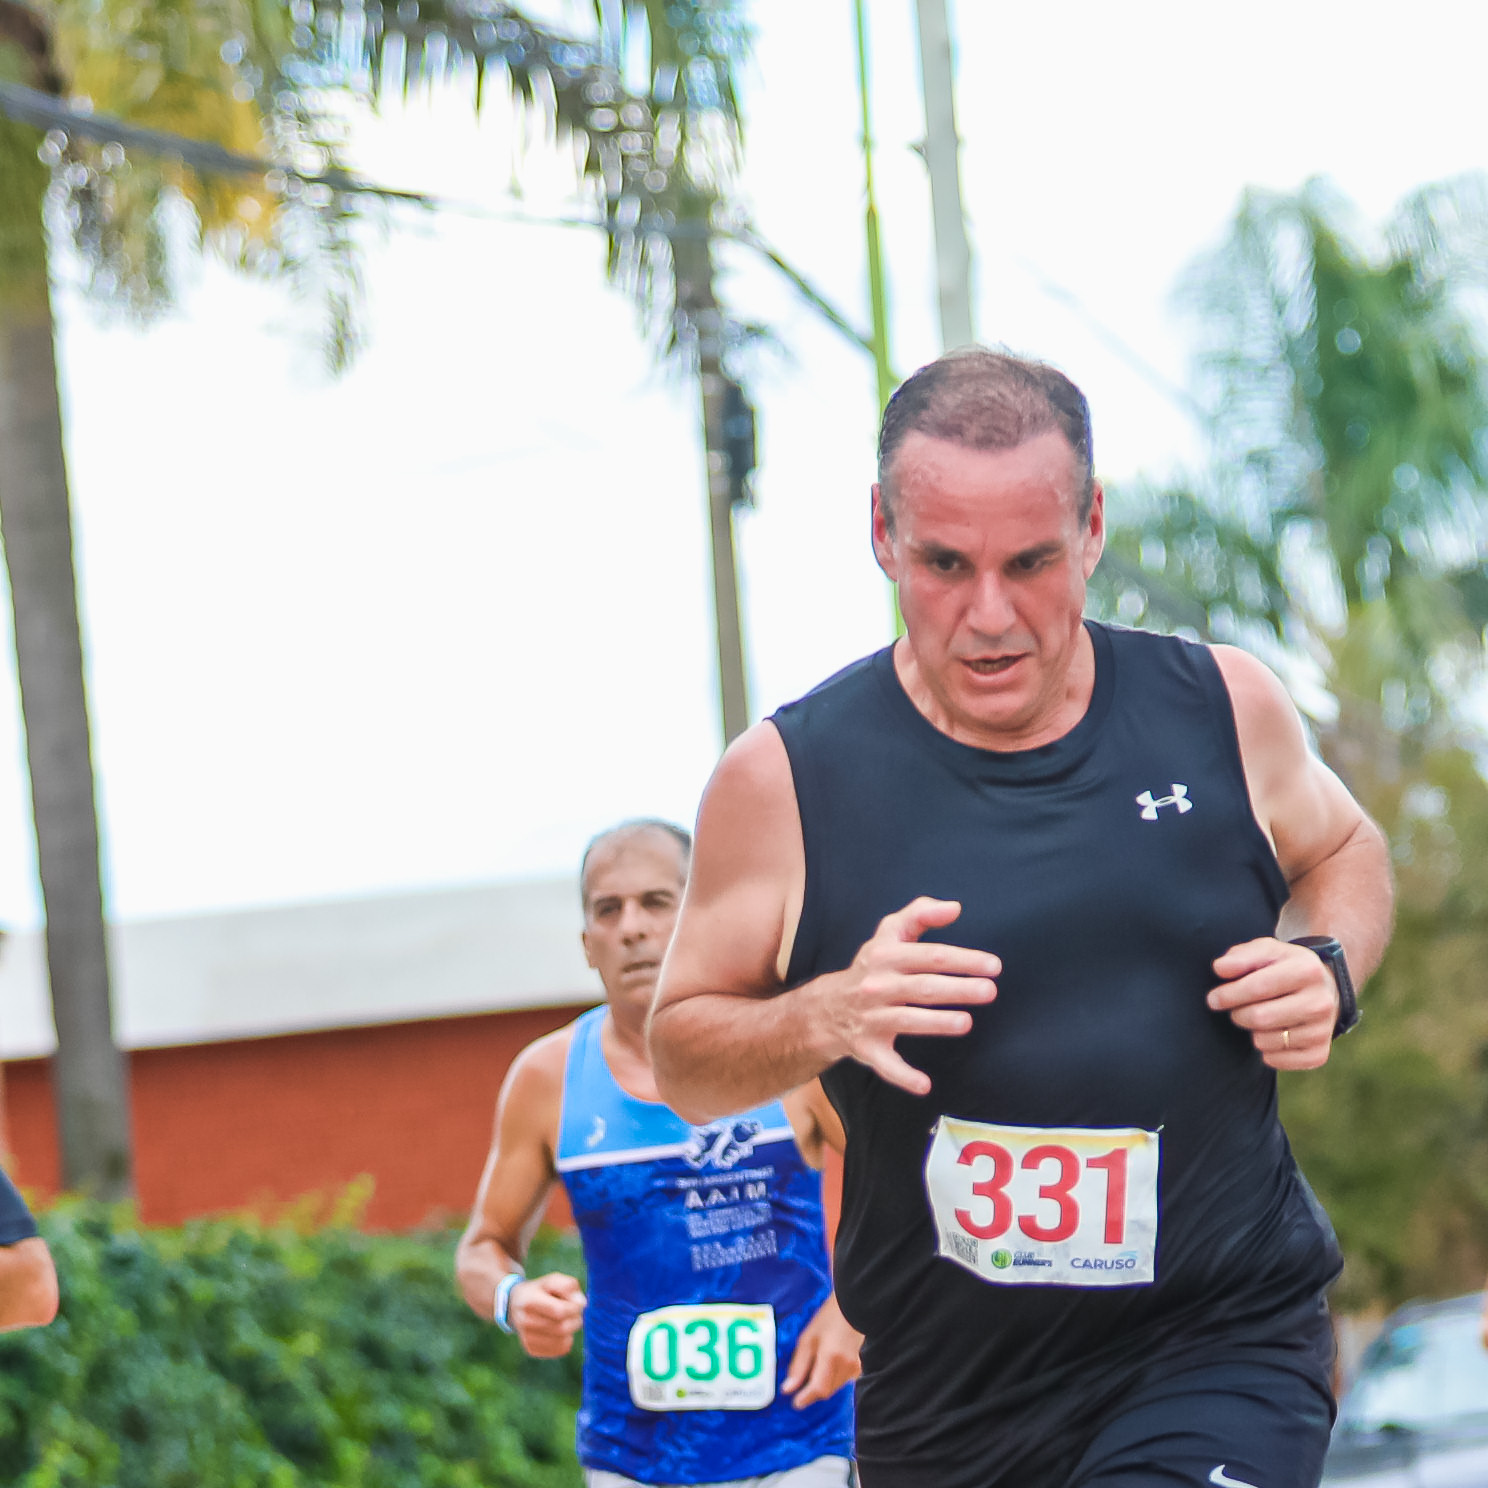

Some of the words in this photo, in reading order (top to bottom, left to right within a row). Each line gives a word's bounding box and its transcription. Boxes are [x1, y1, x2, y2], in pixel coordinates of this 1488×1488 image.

[954, 1139, 1129, 1245] 331
[1070, 1257, 1136, 1270] CARUSO
[642, 1318, 763, 1382] 036
